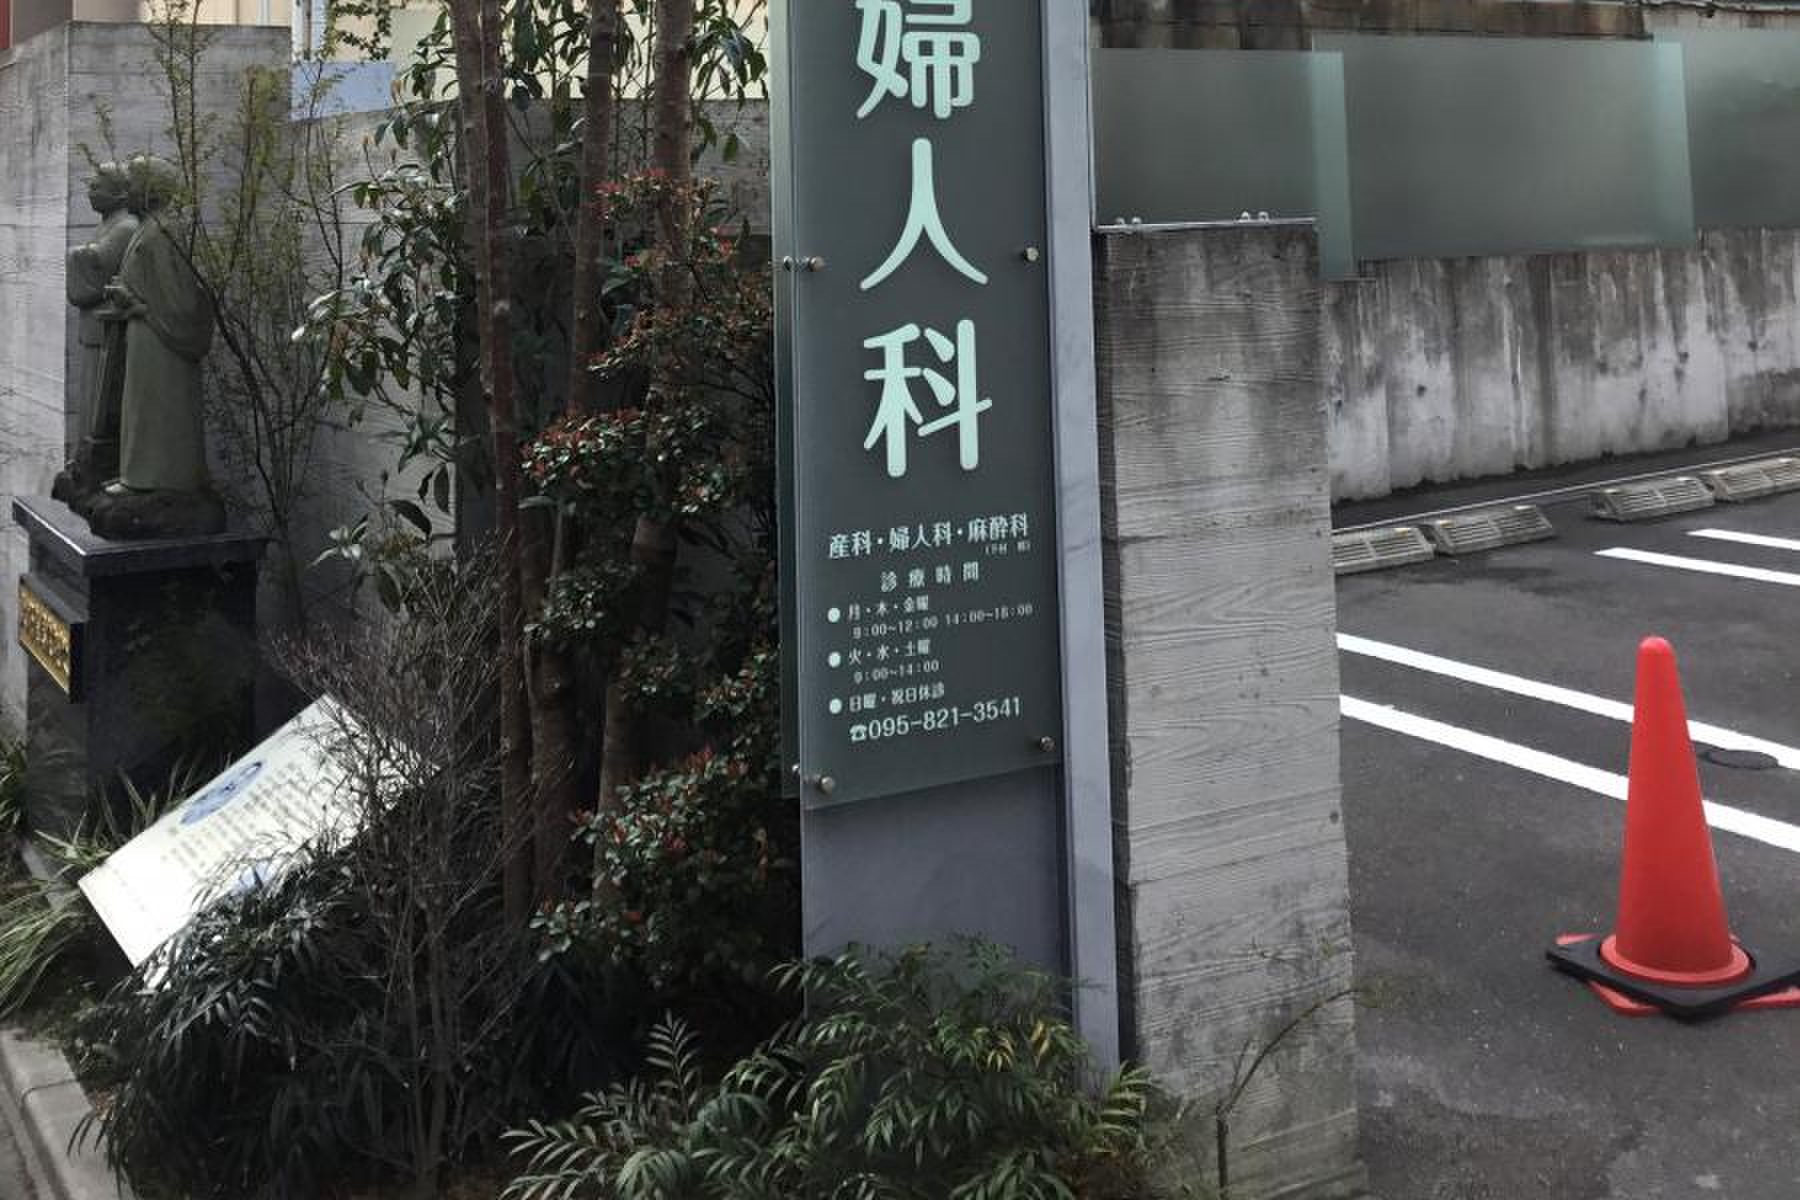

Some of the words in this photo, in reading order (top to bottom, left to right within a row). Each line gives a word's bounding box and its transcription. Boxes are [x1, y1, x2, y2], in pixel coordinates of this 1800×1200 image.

[828, 512, 1028, 560] 産科・婦人科・麻酔科
[867, 696, 1022, 740] 095-821-3541
